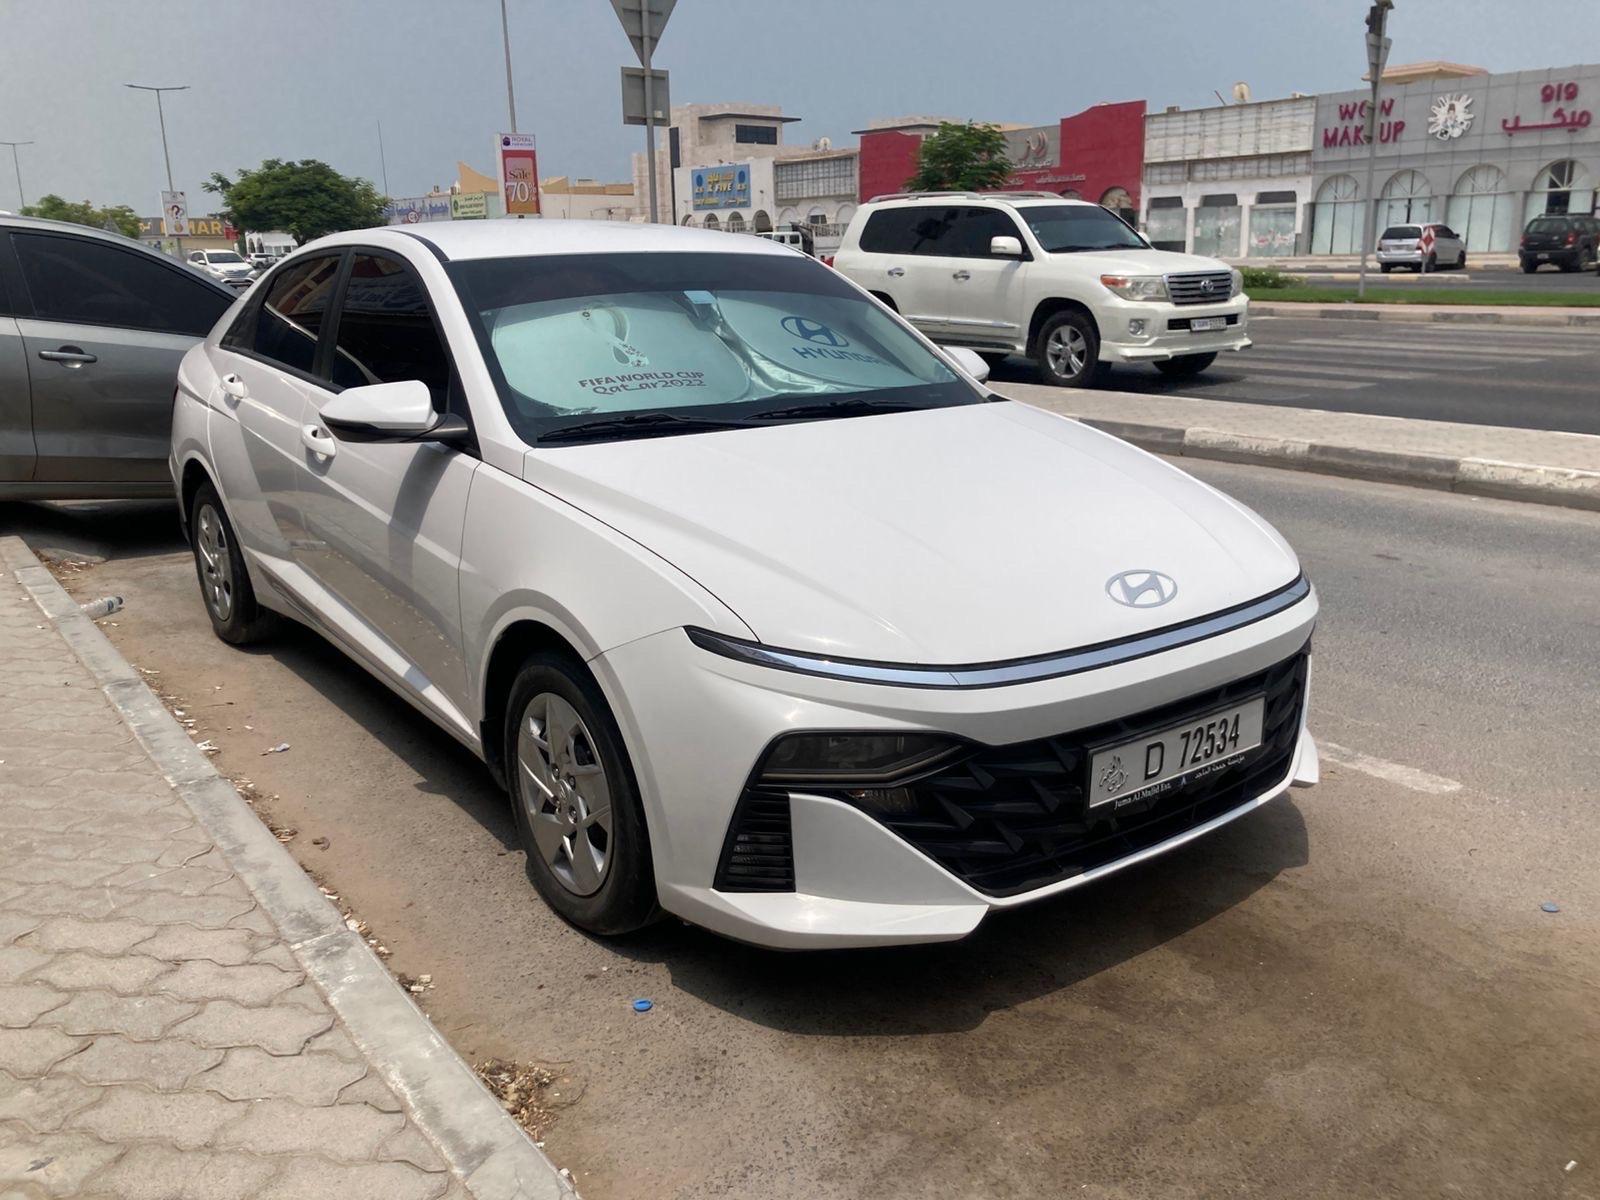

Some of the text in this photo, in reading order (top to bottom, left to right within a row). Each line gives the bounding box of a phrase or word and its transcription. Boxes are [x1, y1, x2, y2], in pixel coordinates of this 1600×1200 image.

[1541, 82, 1578, 103] واو
[1502, 107, 1592, 137] ميكب
[1323, 125, 1365, 149] MAK
[508, 170, 530, 180] Sale
[505, 181, 537, 202] 70%
[578, 371, 705, 388] FIFA WORLD CUP
[1144, 741, 1165, 781] D
[1179, 713, 1240, 769] 72534
